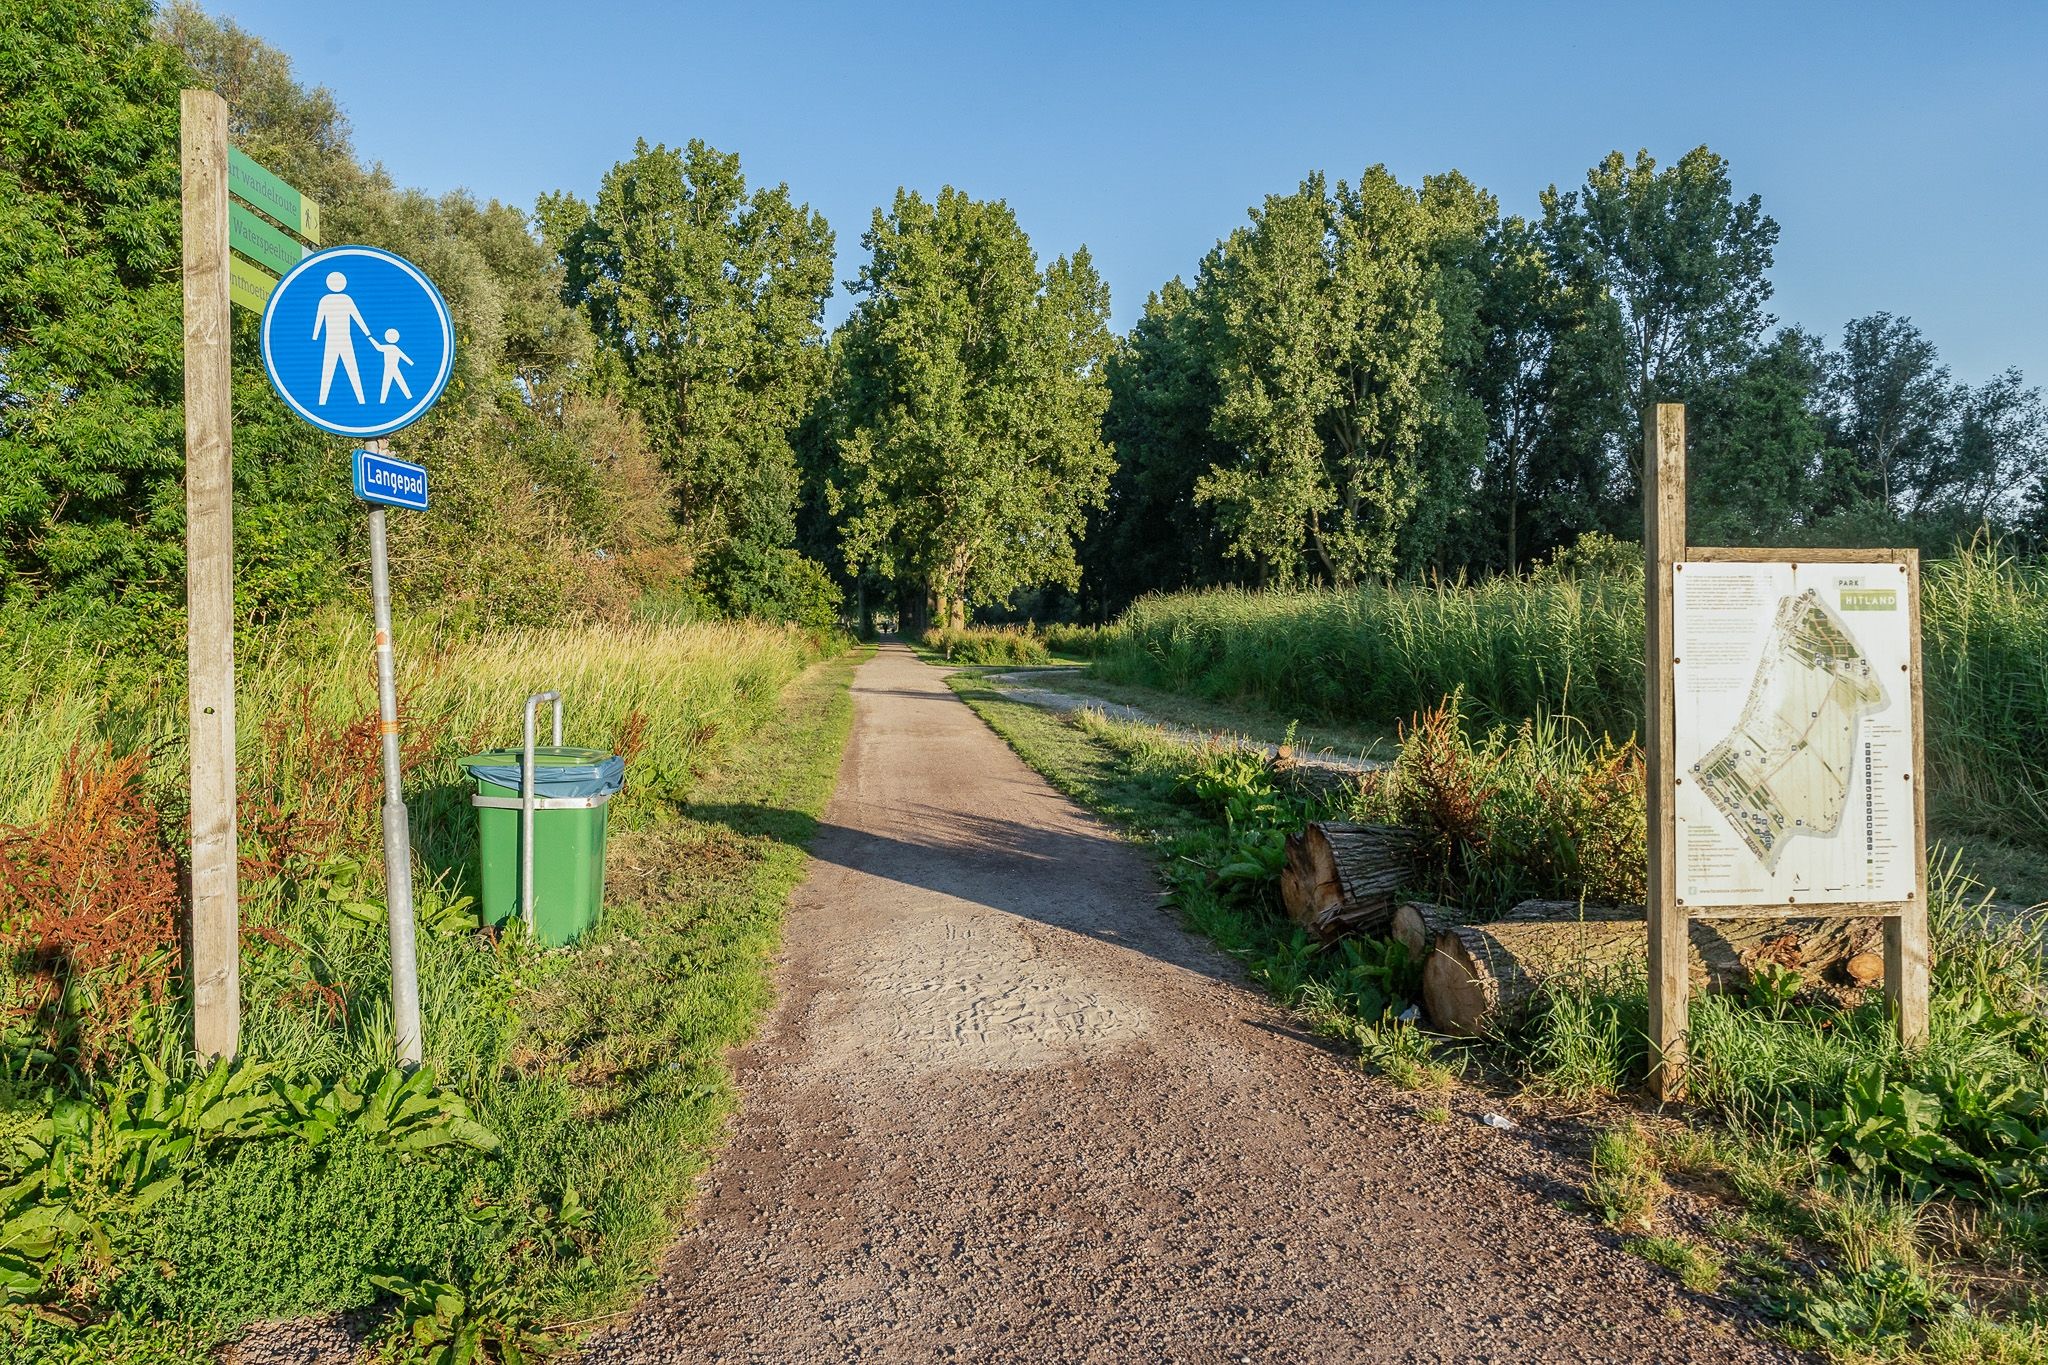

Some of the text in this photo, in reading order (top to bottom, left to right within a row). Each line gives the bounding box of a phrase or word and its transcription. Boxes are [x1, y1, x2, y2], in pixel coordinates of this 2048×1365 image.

[228, 161, 297, 216] art wandelroute
[233, 217, 297, 266] Waterspeeltuin
[368, 461, 423, 495] Langepad
[1845, 596, 1895, 605] HITLAND
